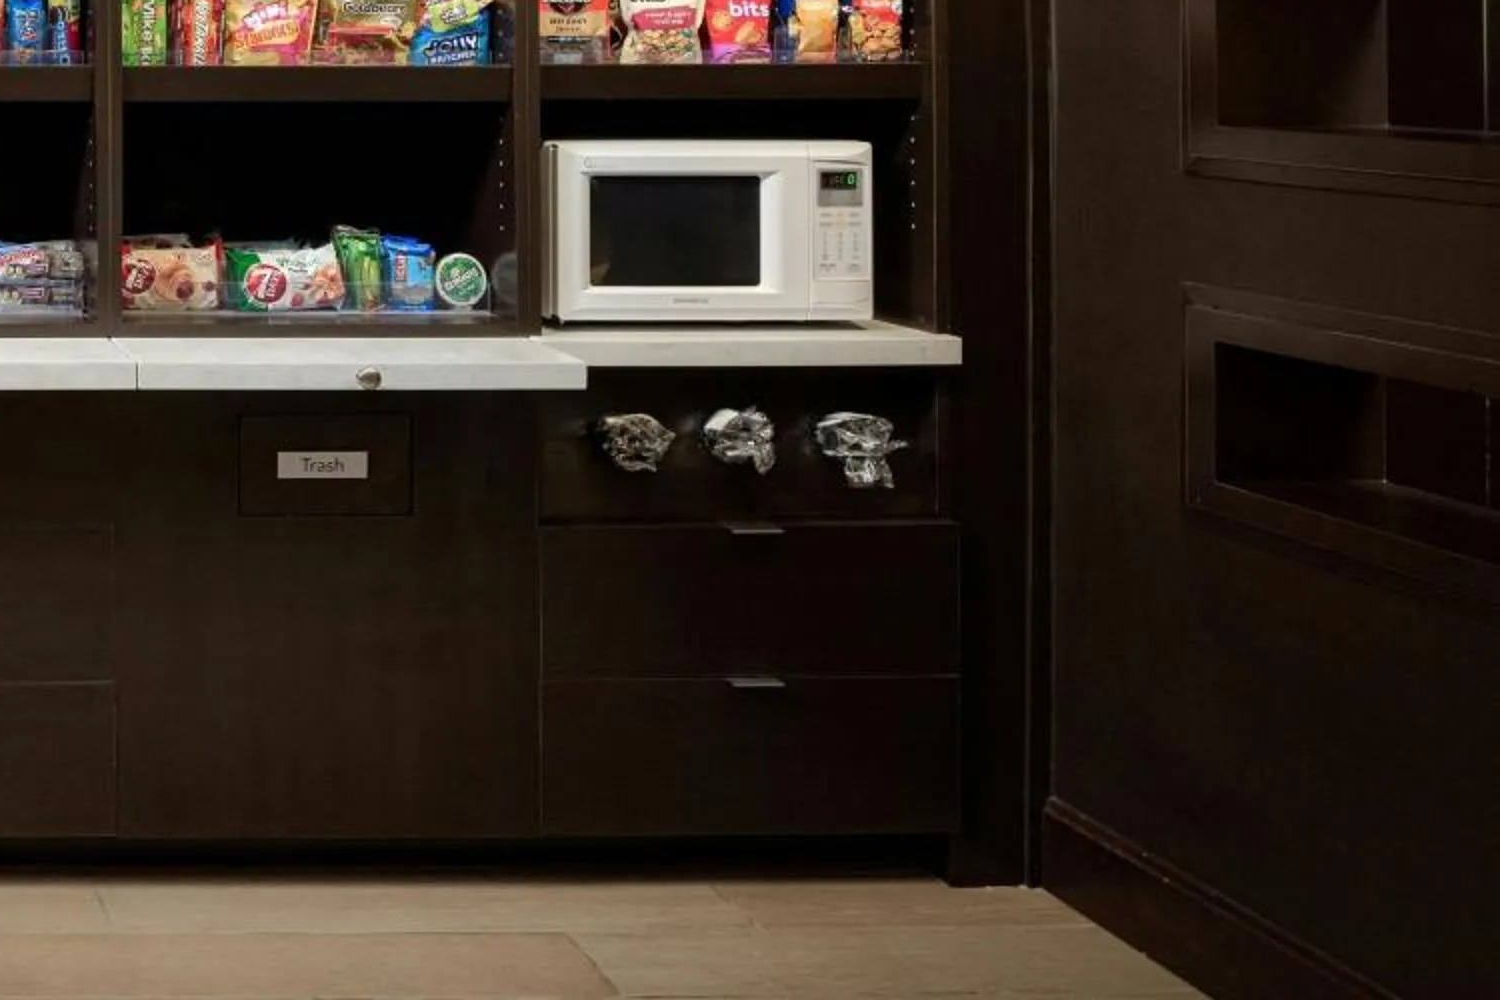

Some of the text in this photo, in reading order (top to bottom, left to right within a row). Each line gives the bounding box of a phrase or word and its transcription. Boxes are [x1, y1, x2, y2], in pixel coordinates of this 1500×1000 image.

[730, 0, 771, 17] bits
[423, 35, 478, 58] JOLLY
[302, 457, 346, 473] Trash
